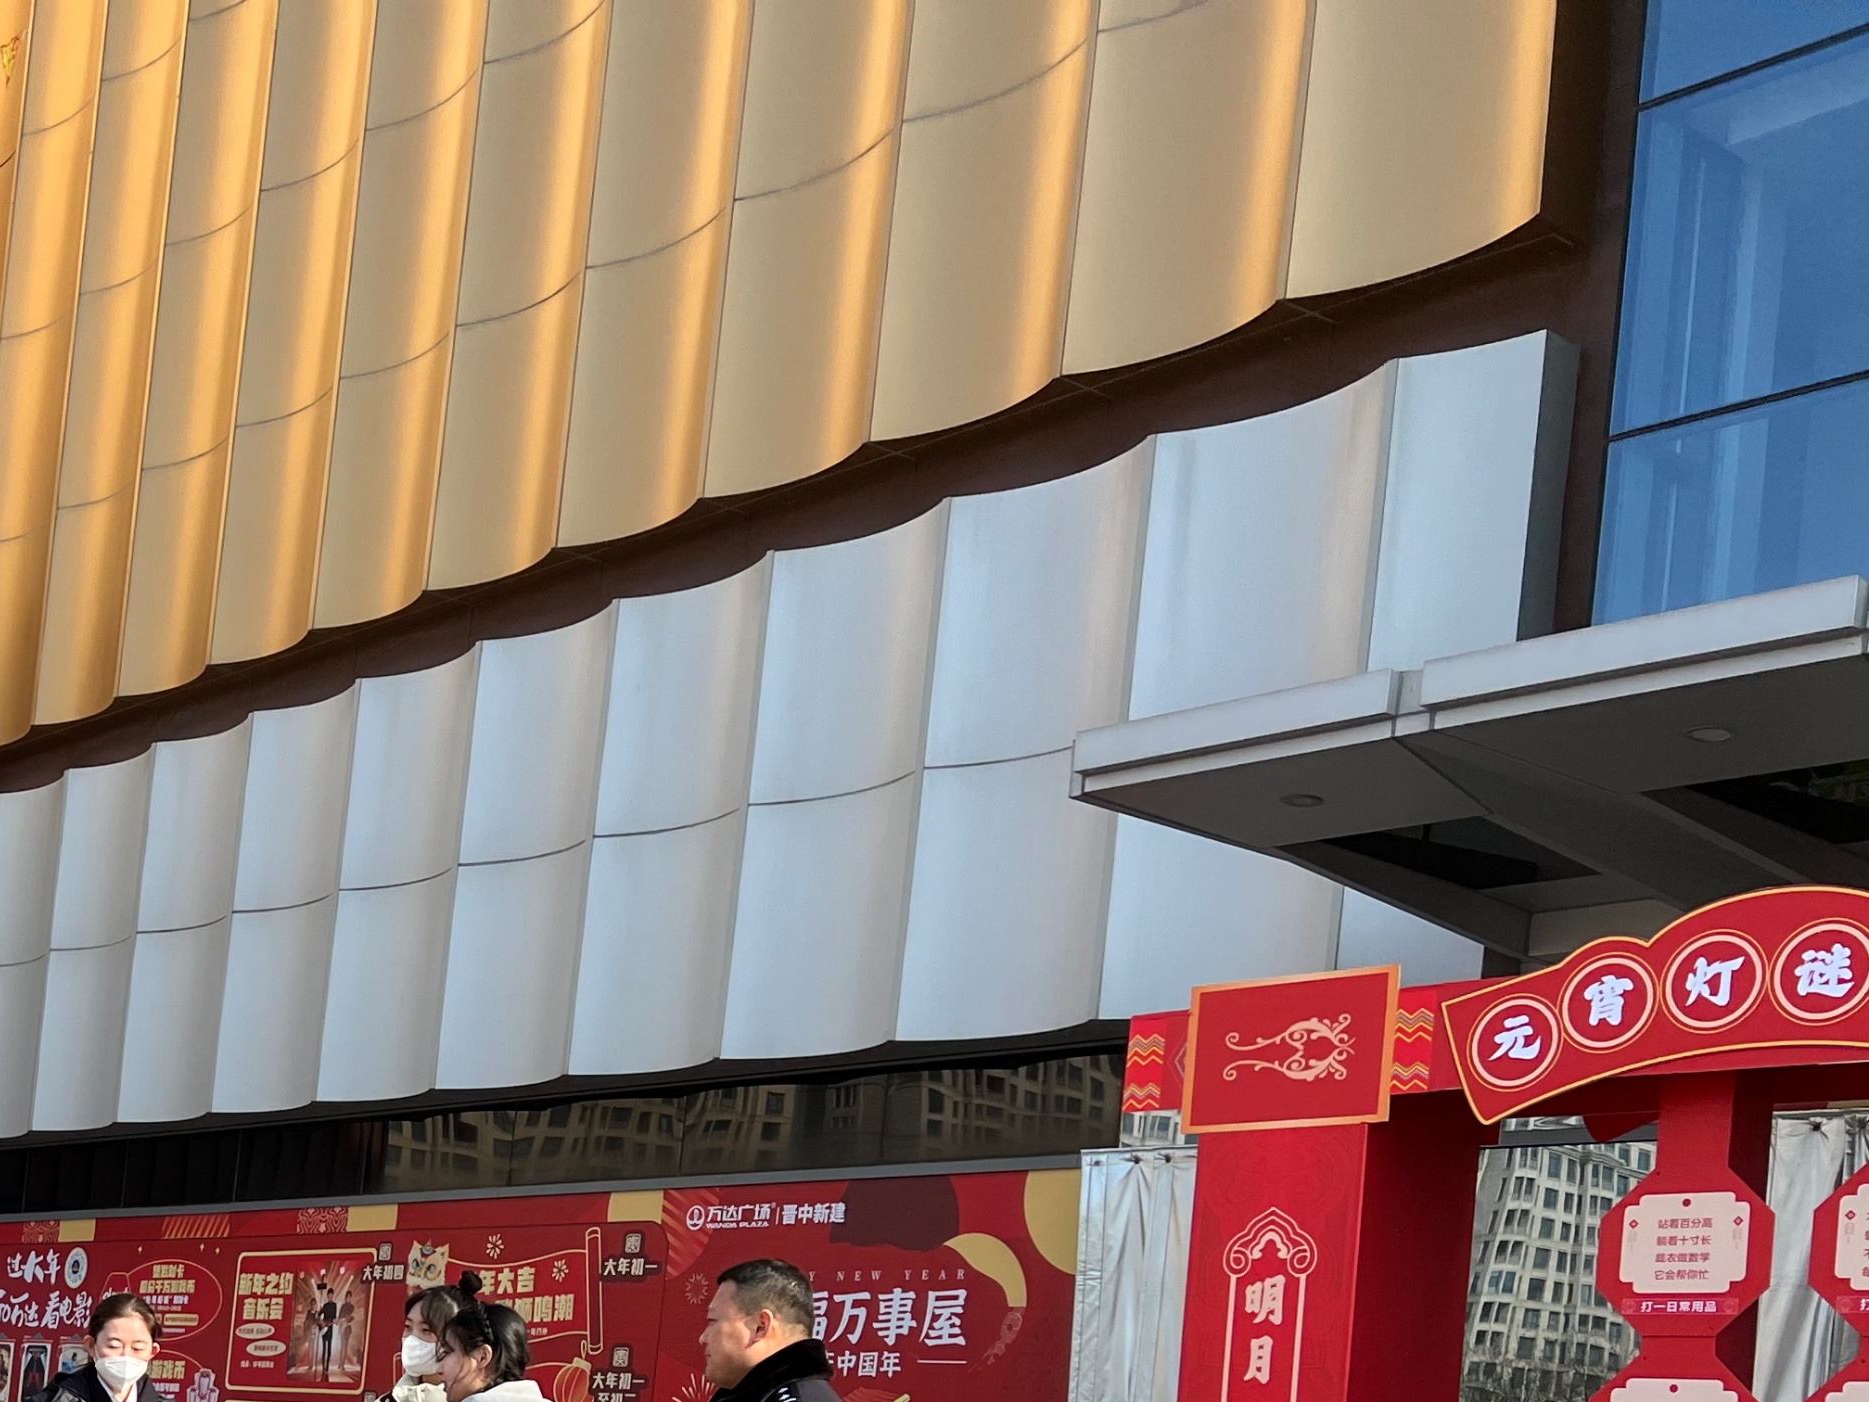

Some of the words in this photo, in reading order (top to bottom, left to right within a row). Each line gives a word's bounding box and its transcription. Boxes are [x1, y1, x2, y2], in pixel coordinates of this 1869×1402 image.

[1487, 942, 1855, 1062] 元宵灯谜
[707, 1203, 771, 1223] 万达广场
[782, 1202, 846, 1225] 晋中新建
[1657, 1217, 1714, 1229] 站着百分高
[706, 1221, 737, 1229] WANDA
[739, 1221, 770, 1229] PLAZA
[7, 1248, 61, 1285] 过大年
[362, 1264, 405, 1281] 大年初四
[603, 1256, 658, 1276] 大年初一
[836, 1270, 882, 1281] NEW
[904, 1269, 966, 1280] YEAR
[1654, 1269, 1710, 1281] 它会帮你忙
[238, 1272, 294, 1296] 新年之约
[242, 1298, 284, 1320] 音乐会
[1640, 1301, 1718, 1313] 打一日常用品
[827, 1350, 902, 1379] 中国年
[593, 1372, 645, 1391] 大年初一
